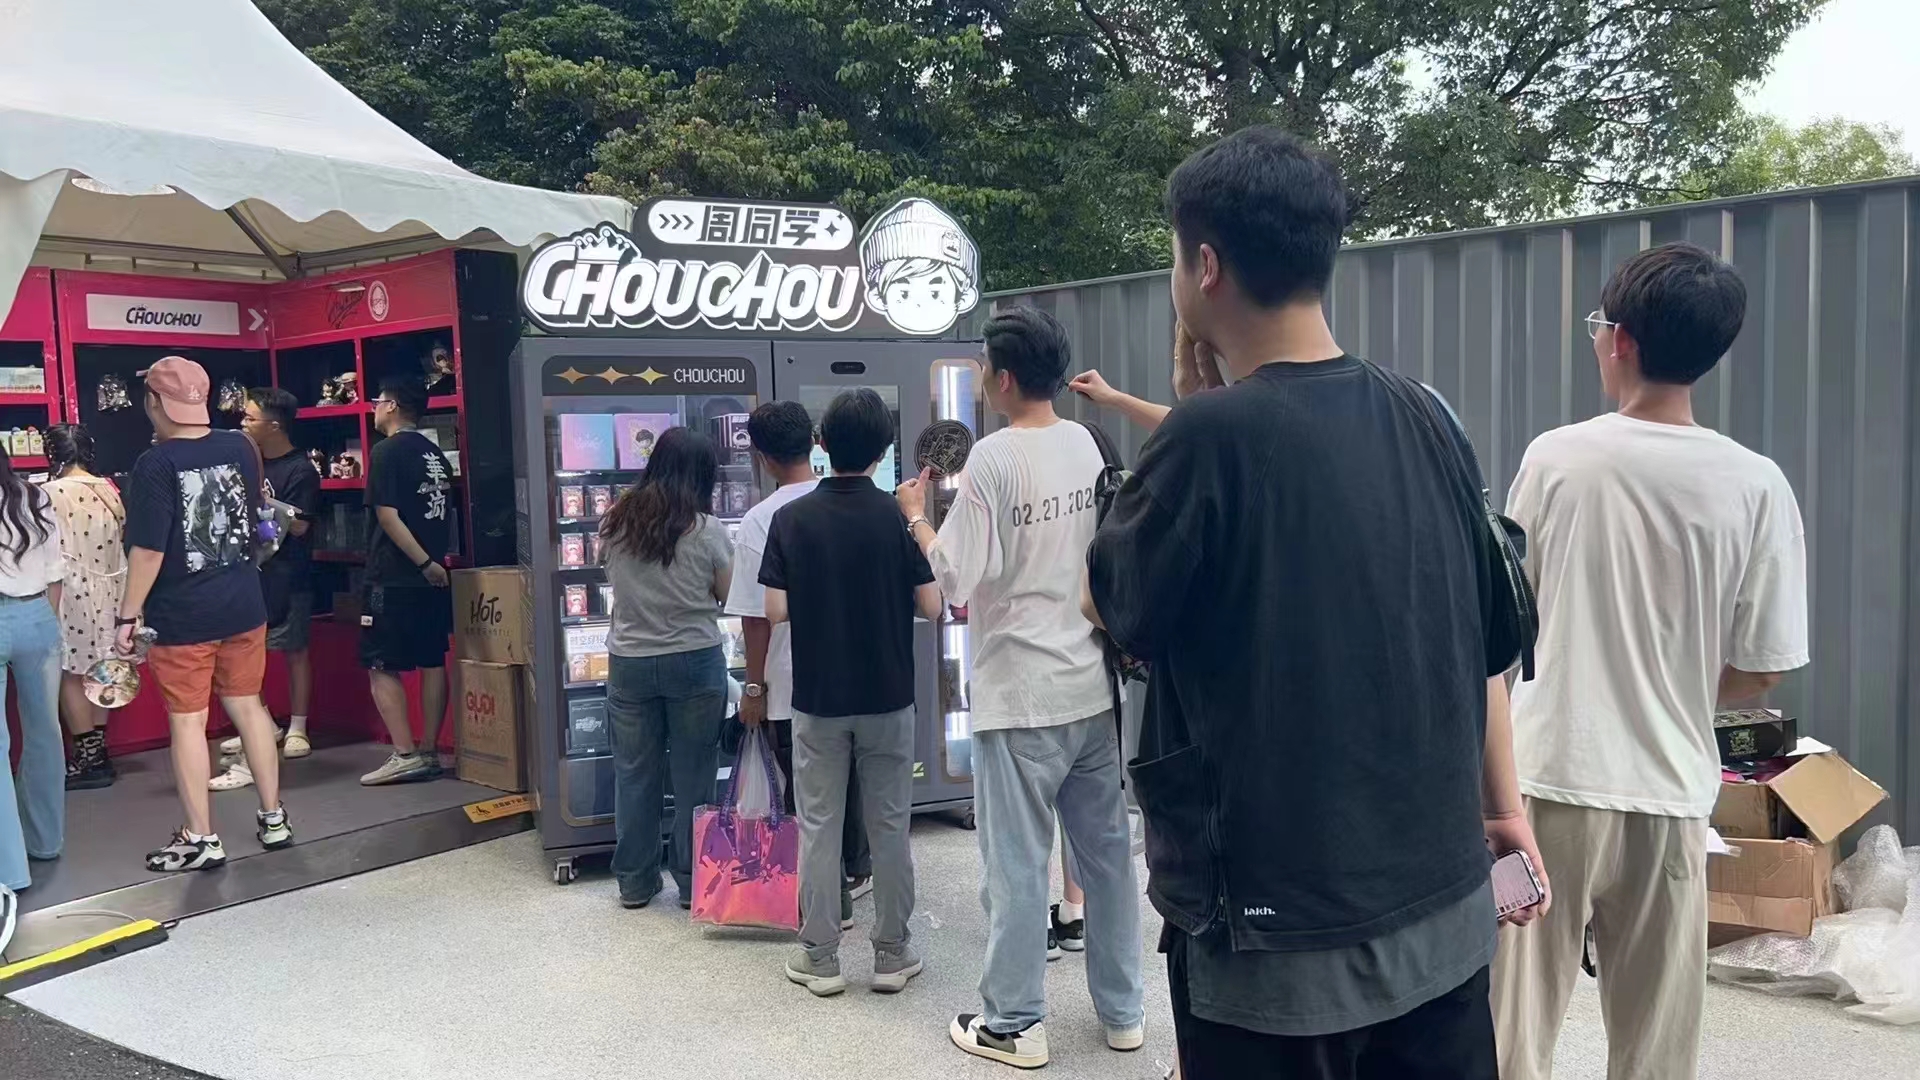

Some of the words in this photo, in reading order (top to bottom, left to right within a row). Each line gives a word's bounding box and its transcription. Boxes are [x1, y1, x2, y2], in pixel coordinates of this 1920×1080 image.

[696, 204, 821, 246] 周同学
[524, 242, 862, 328] CHOUCHOU
[125, 306, 202, 327] CHOUCHOU
[673, 368, 745, 383] CHOUCHOU
[1012, 487, 1093, 527] 02.27.202
